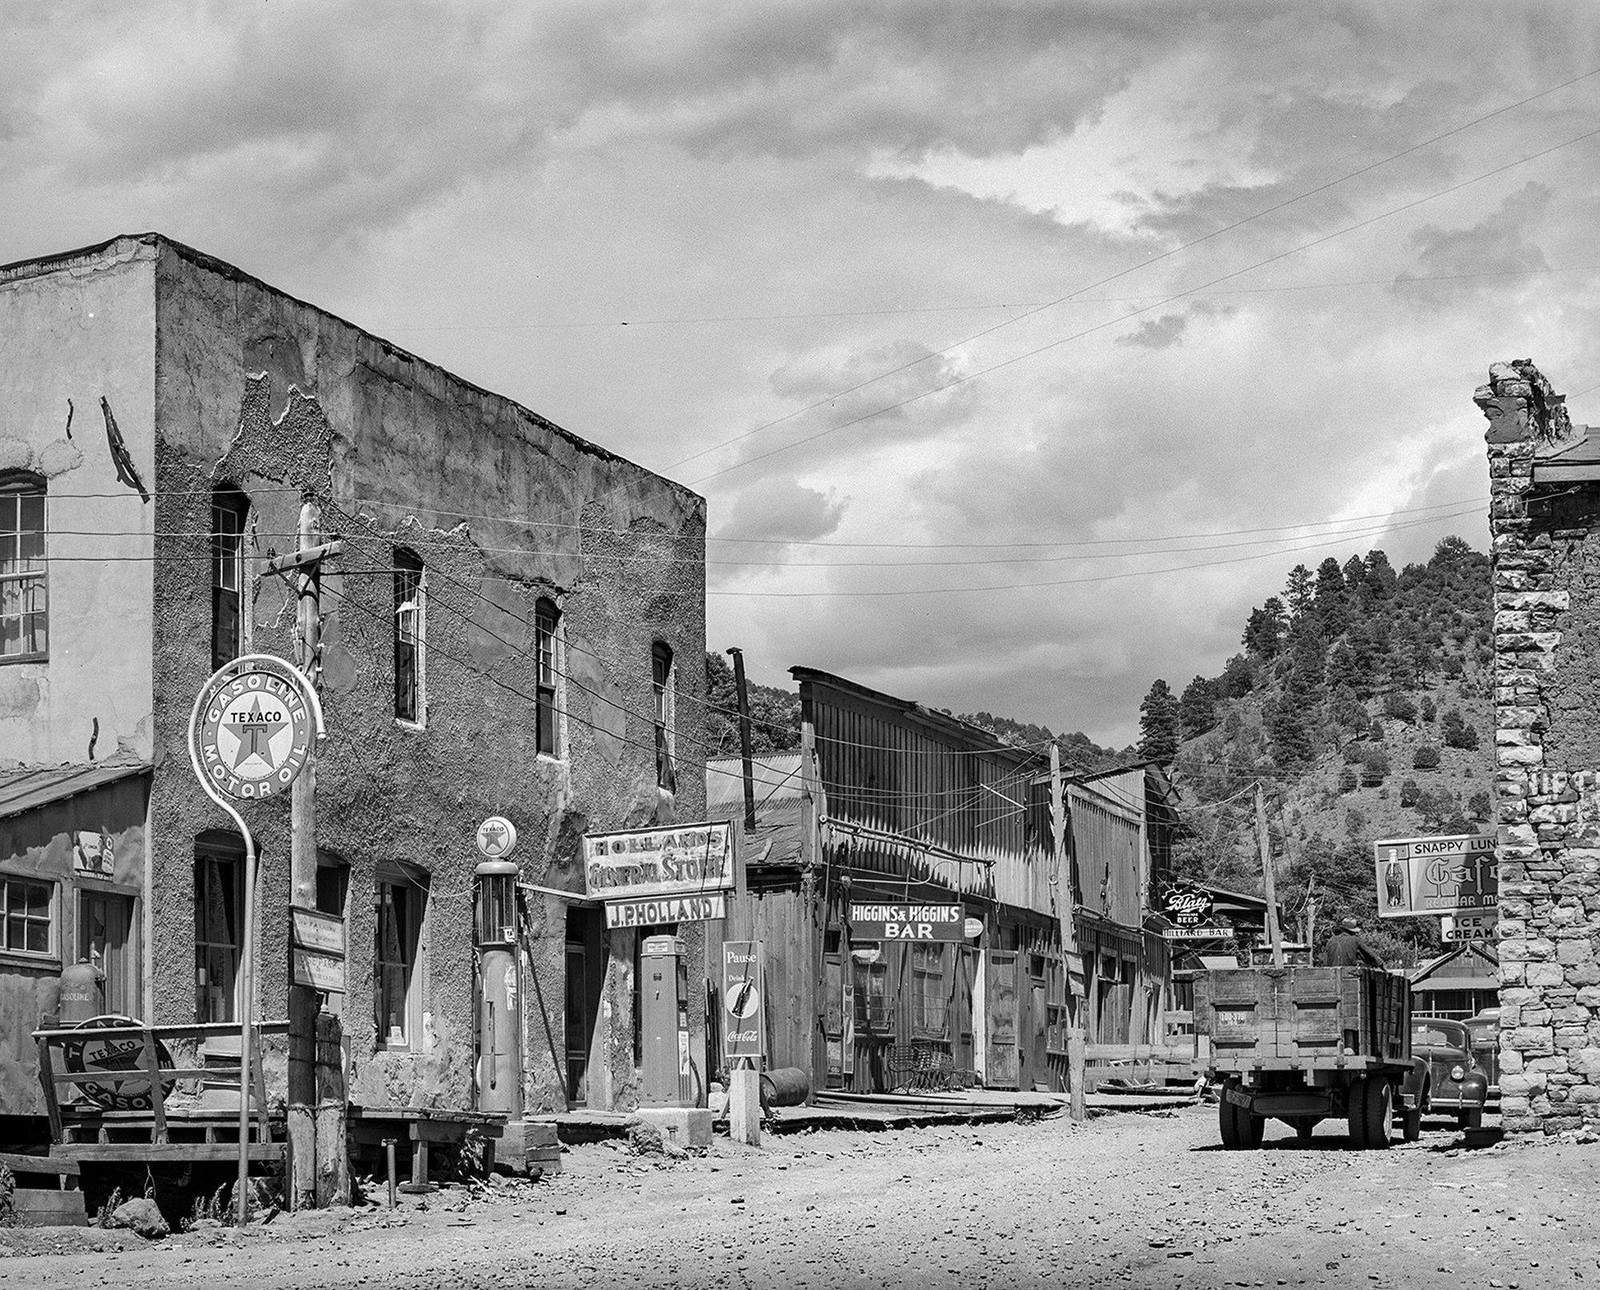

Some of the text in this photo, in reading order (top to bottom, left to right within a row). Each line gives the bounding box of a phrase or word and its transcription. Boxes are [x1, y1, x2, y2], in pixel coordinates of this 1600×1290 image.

[208, 674, 306, 724] GASOLINE
[231, 711, 282, 723] TEXACO
[203, 744, 306, 797] MOTOR OIL
[594, 830, 723, 857] HOLLANDS
[1414, 838, 1499, 855] SNAPPY LUN
[1165, 893, 1212, 913] Blatz
[908, 905, 960, 923] HIGGINS
[1176, 916, 1199, 924] BEER
[1454, 917, 1482, 928] ICE
[884, 923, 934, 939] BAR
[1209, 929, 1229, 937] BAR
[1445, 928, 1494, 940] CREAM
[726, 951, 757, 964] Pause
[88, 1040, 136, 1061] TEXACO
